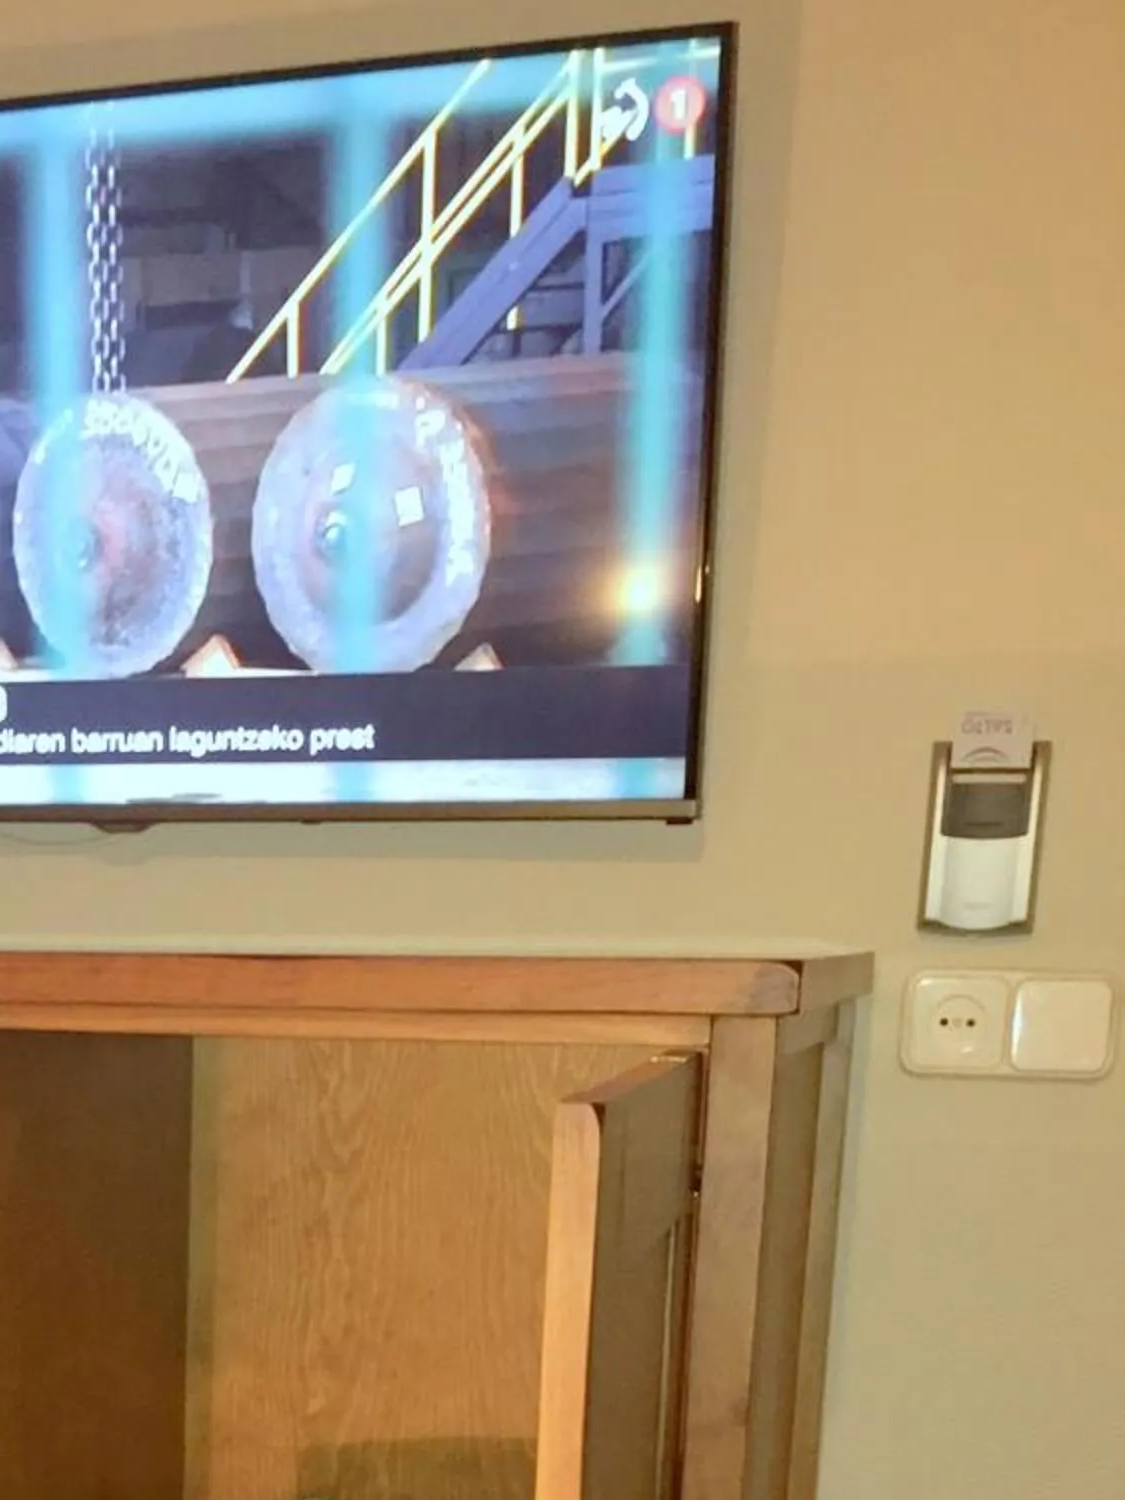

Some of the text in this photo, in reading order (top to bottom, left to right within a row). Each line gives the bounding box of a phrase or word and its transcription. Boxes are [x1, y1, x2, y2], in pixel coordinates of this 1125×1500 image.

[71, 726, 164, 753] barruan
[170, 723, 303, 757] laguntzeko
[310, 724, 376, 755] prest
